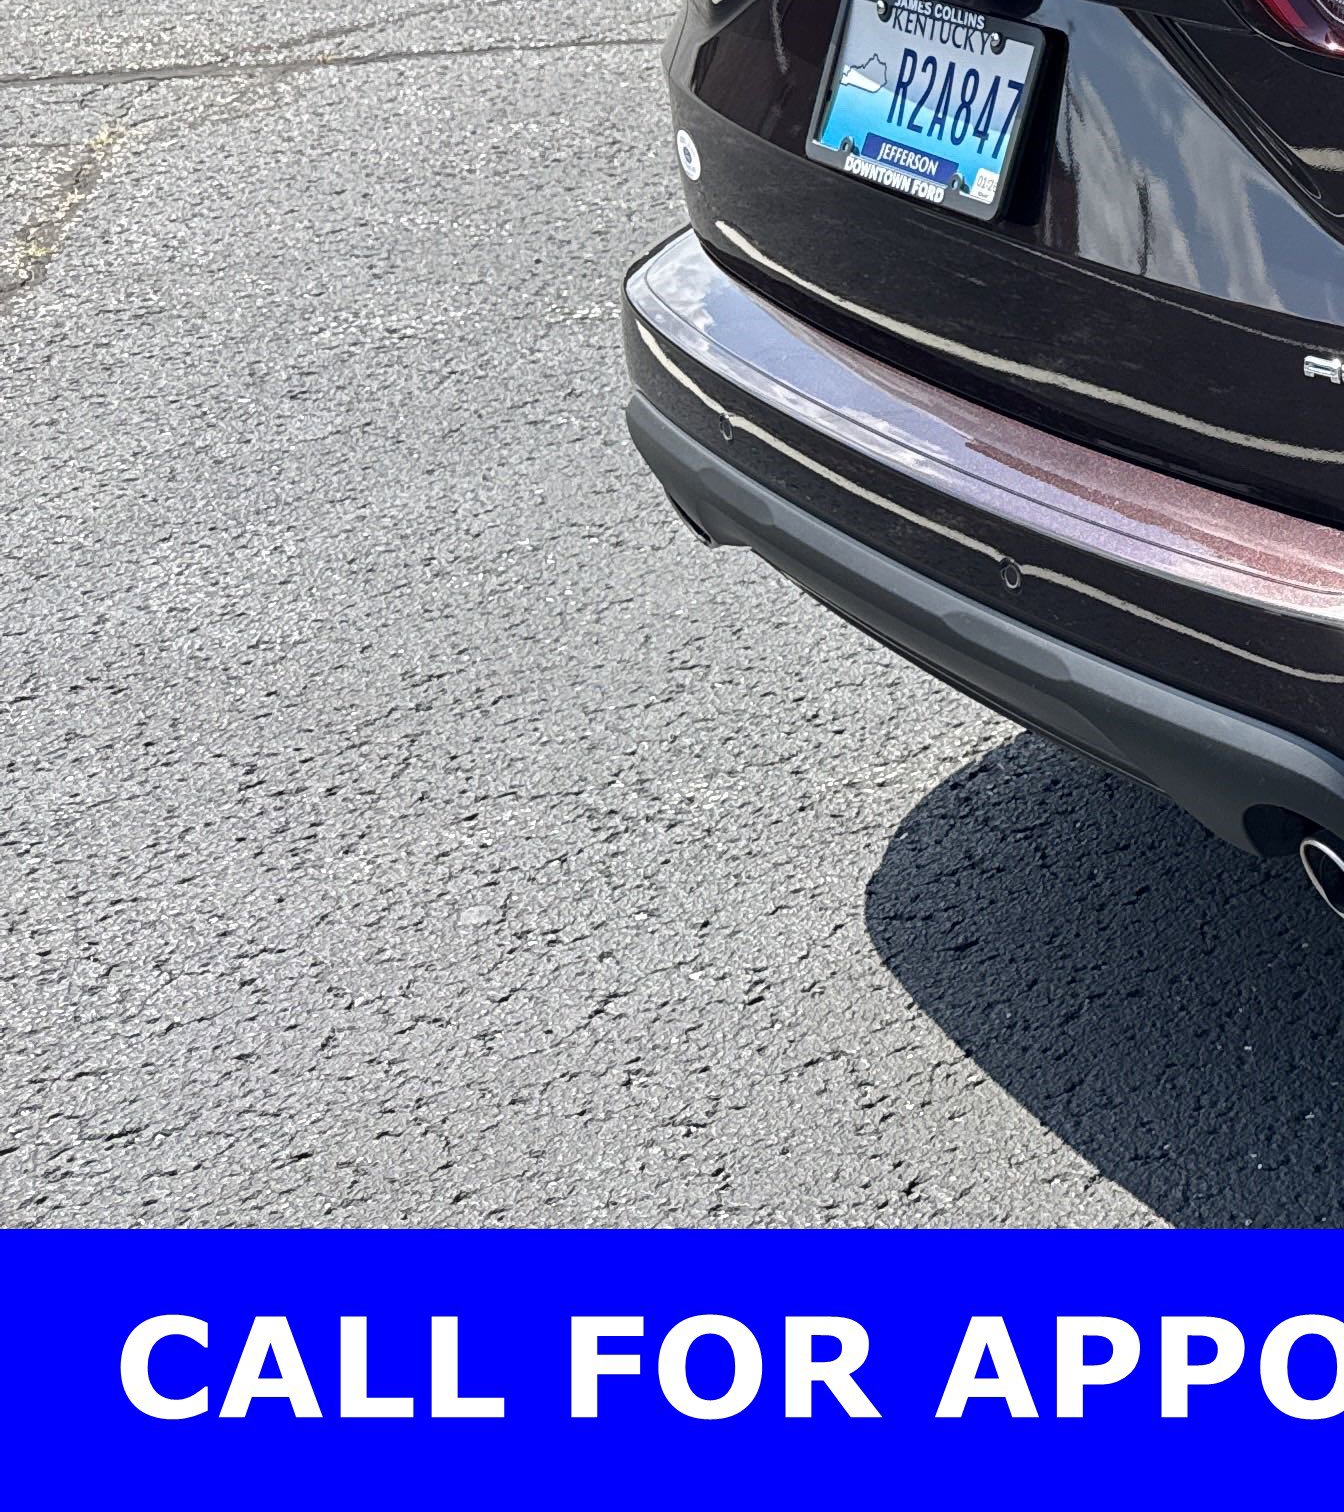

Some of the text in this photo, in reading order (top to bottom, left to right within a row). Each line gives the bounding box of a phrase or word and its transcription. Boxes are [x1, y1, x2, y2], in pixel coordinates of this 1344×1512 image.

[892, 7, 993, 56] KENTUCKY
[934, 3, 986, 30] COLLINS
[886, 47, 1024, 160] R2A847
[843, 155, 945, 204] DOWNTOWN FORD
[877, 142, 939, 177] JEFFERSON
